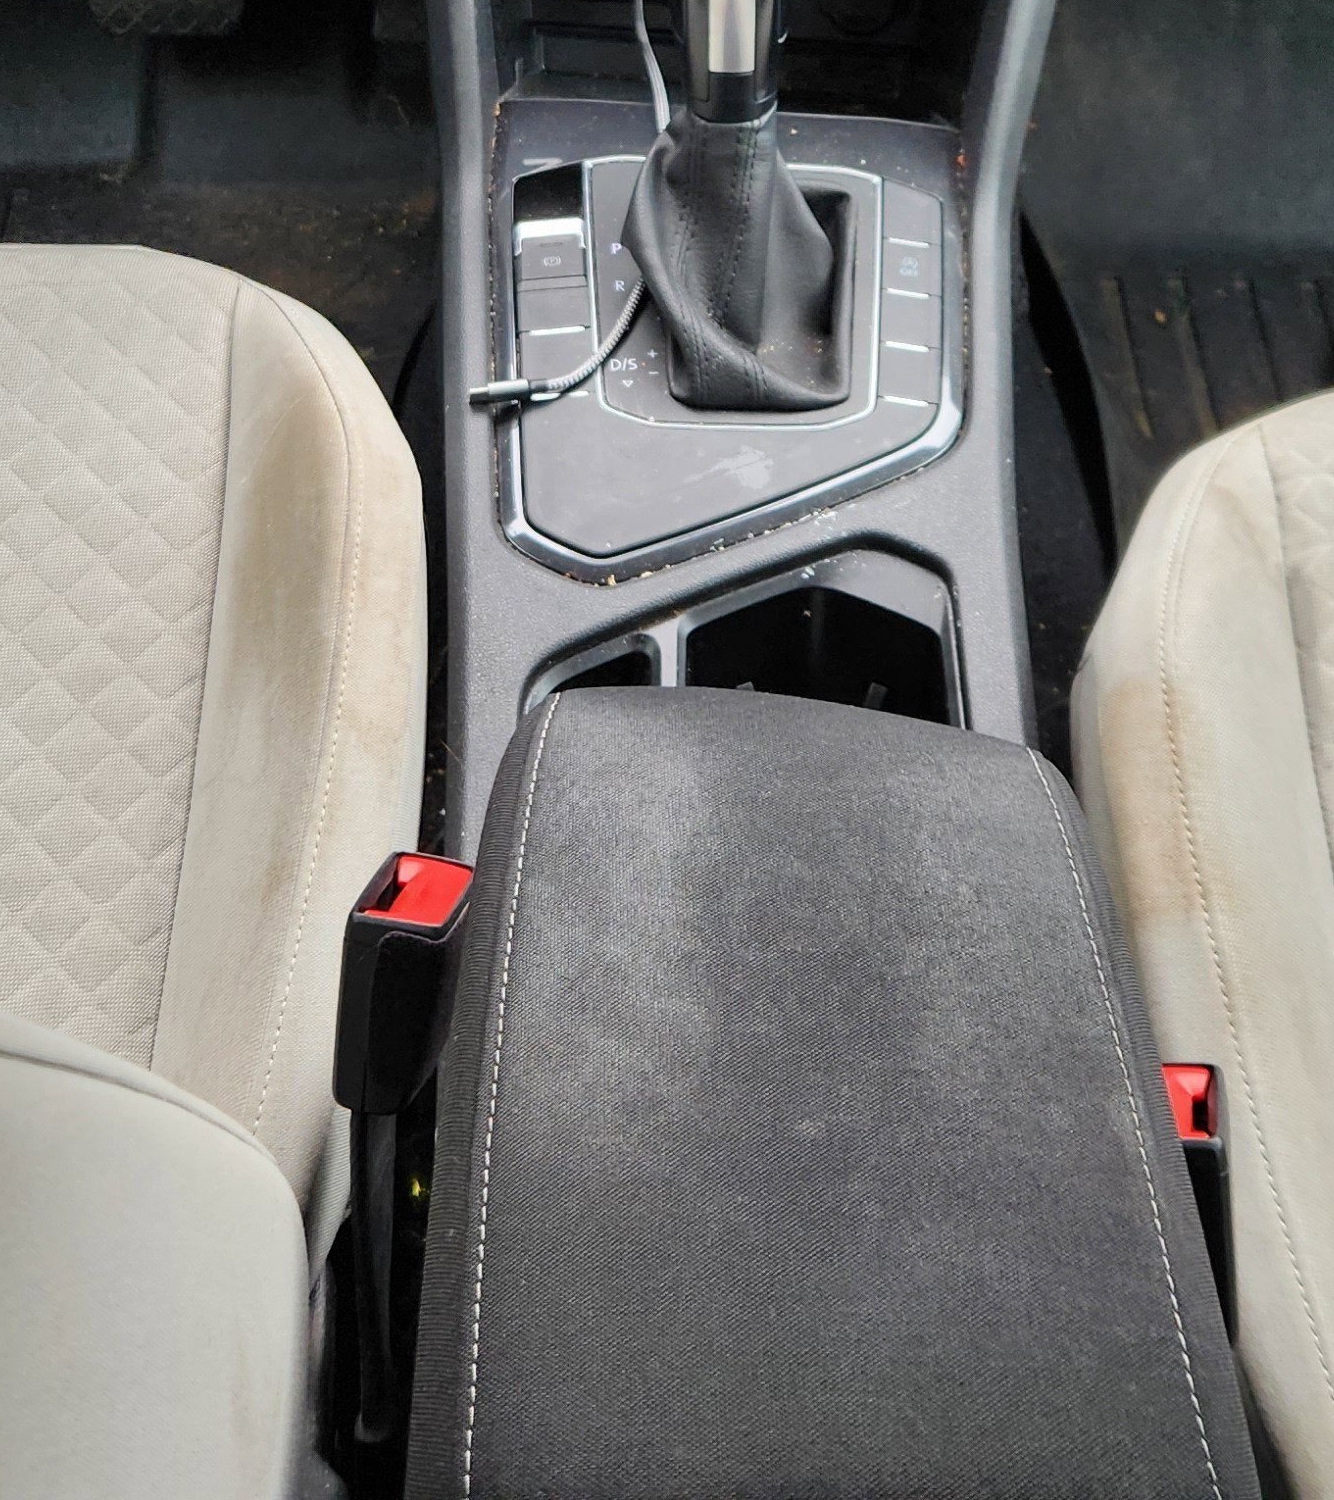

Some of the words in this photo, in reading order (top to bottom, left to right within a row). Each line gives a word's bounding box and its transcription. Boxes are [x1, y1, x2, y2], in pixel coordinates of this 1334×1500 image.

[610, 242, 622, 254] P
[614, 280, 625, 292] R
[610, 358, 638, 371] D/S
